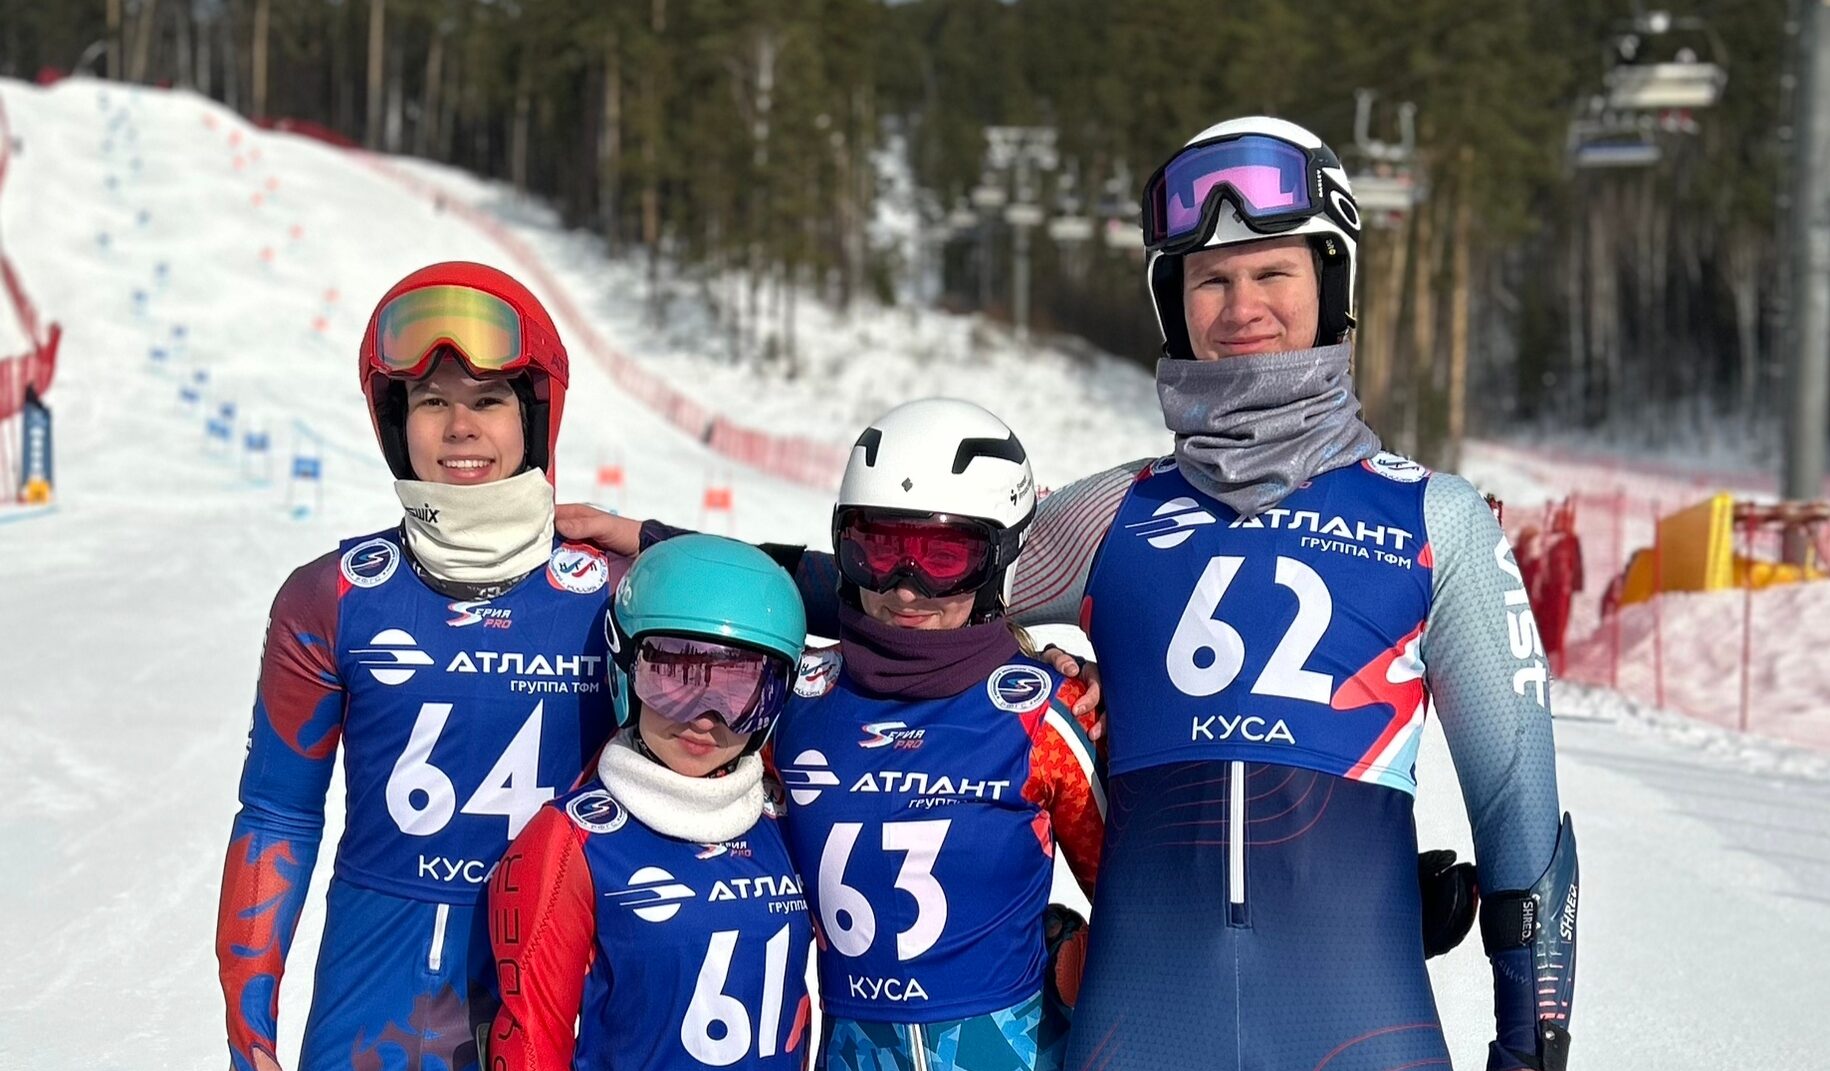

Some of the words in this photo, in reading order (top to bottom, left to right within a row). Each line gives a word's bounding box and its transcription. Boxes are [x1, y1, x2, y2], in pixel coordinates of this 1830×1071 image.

[1229, 508, 1413, 551] АТЛАНТ
[1300, 536, 1370, 559] ГРУППА
[1373, 550, 1412, 570] ТФМ
[484, 618, 512, 630] PRO
[1165, 555, 1335, 706] 62
[446, 651, 601, 676] АТЛАНТ
[510, 680, 569, 694] ГРУППА
[573, 682, 600, 694] ТФМ
[1191, 715, 1296, 745] КУСА
[386, 698, 555, 841] 64
[849, 771, 1010, 800] АТЛАНТ
[908, 797, 962, 810] ГРУПП
[707, 874, 804, 902] АТЛА
[818, 818, 952, 961] 63
[680, 922, 790, 1066] 61
[849, 974, 929, 1001] КУСА
